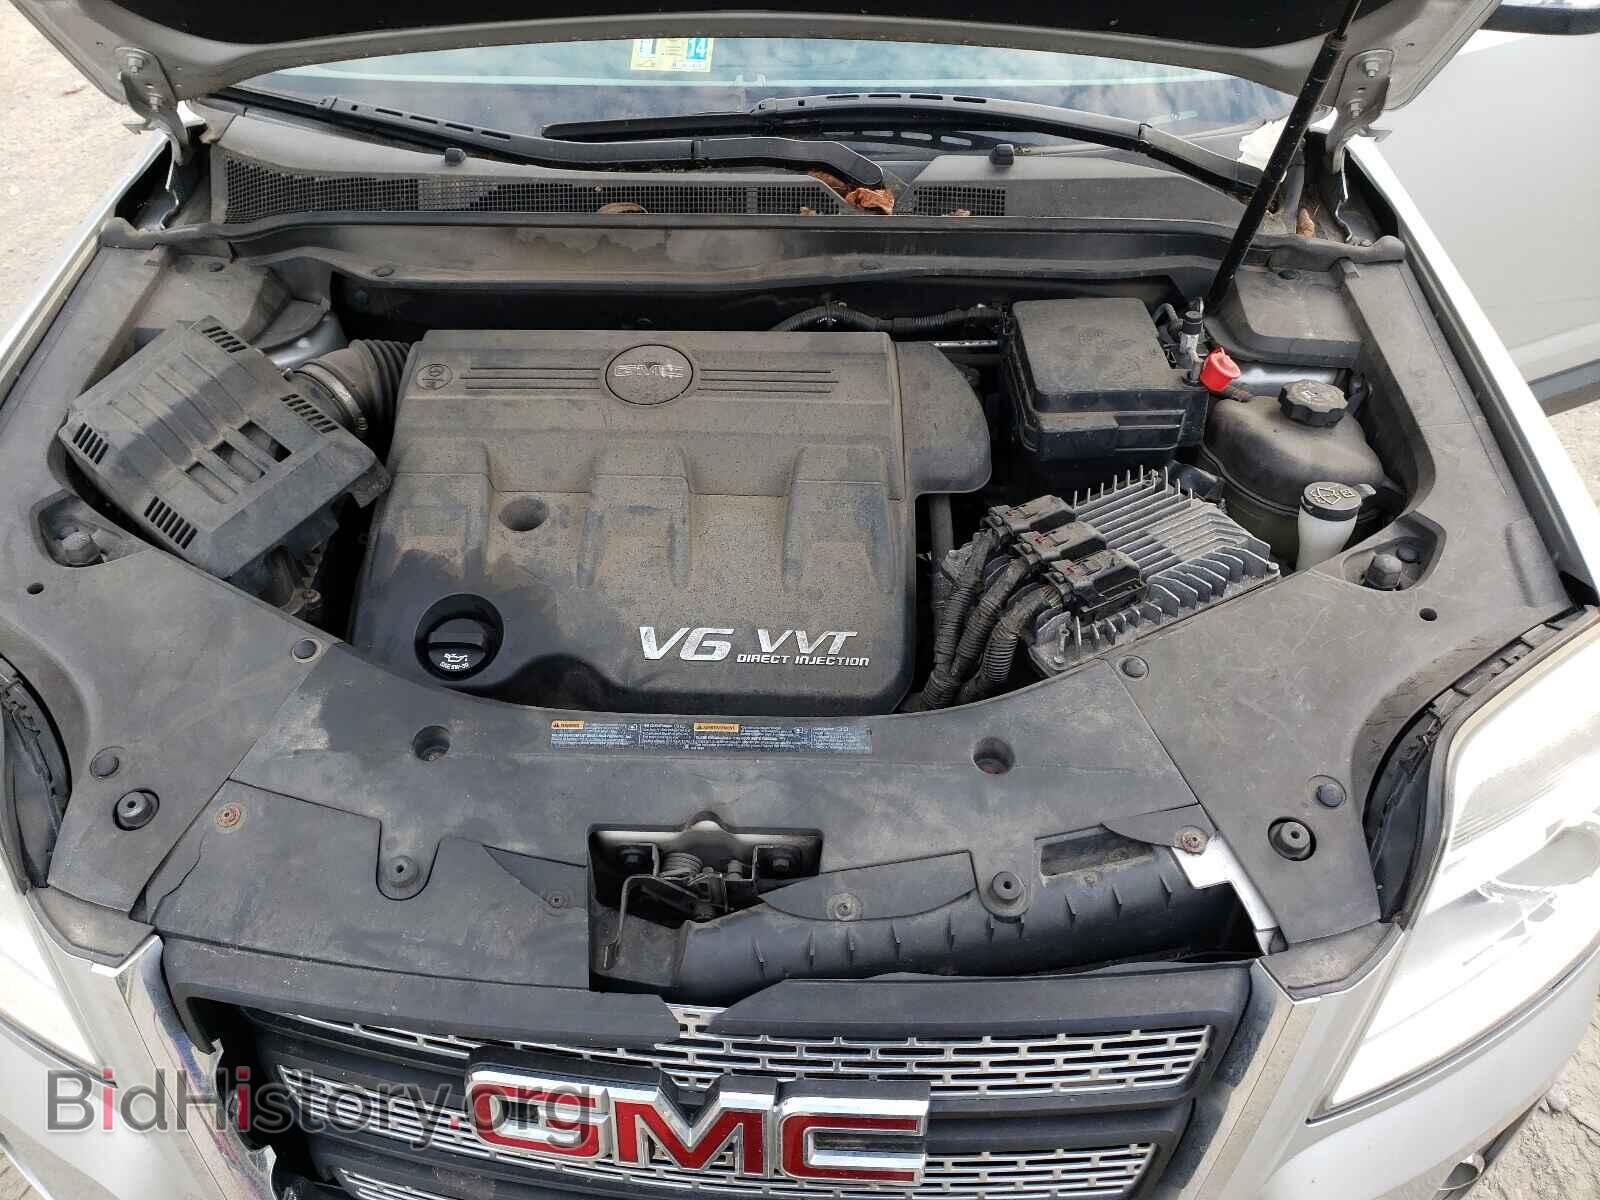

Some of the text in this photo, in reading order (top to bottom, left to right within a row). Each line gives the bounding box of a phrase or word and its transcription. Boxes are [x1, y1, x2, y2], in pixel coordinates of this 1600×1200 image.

[639, 626, 858, 661] V6 VVT
[736, 654, 870, 667] DIRECT INJECTION
[466, 1067, 929, 1186] GMC
